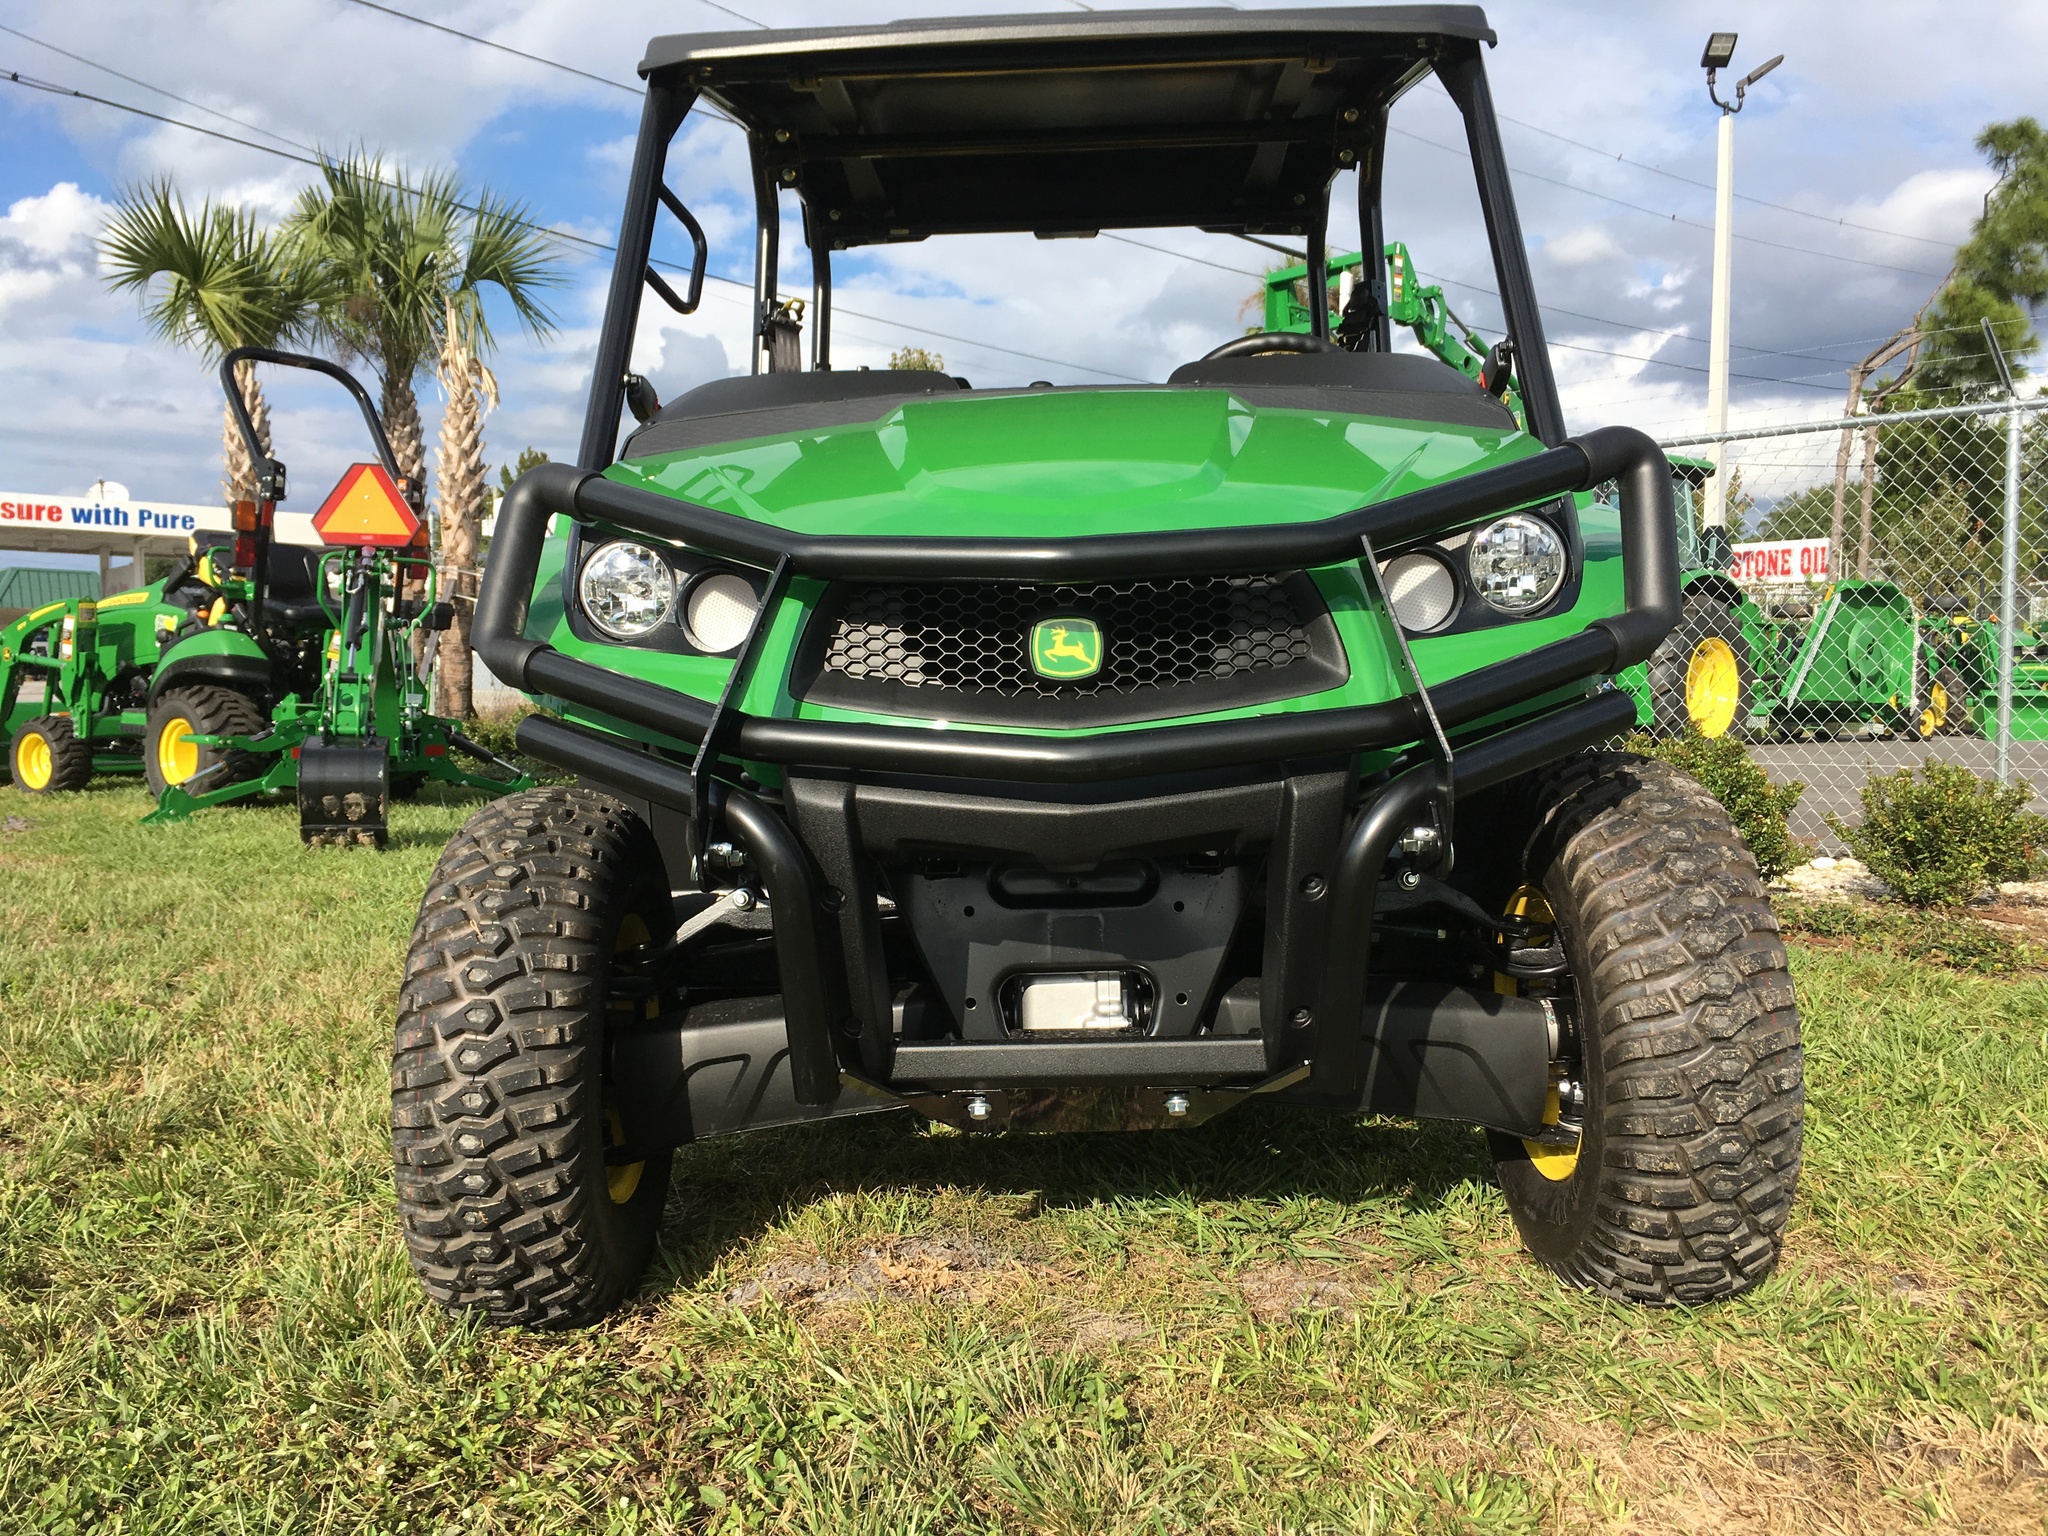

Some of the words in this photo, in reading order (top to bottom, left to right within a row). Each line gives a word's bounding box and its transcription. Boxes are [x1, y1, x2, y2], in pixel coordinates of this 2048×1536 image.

[0, 502, 63, 522] sure
[71, 503, 129, 526] with
[138, 509, 195, 530] Pure
[1724, 549, 1792, 578] STONE
[1801, 546, 1828, 575] OIL
